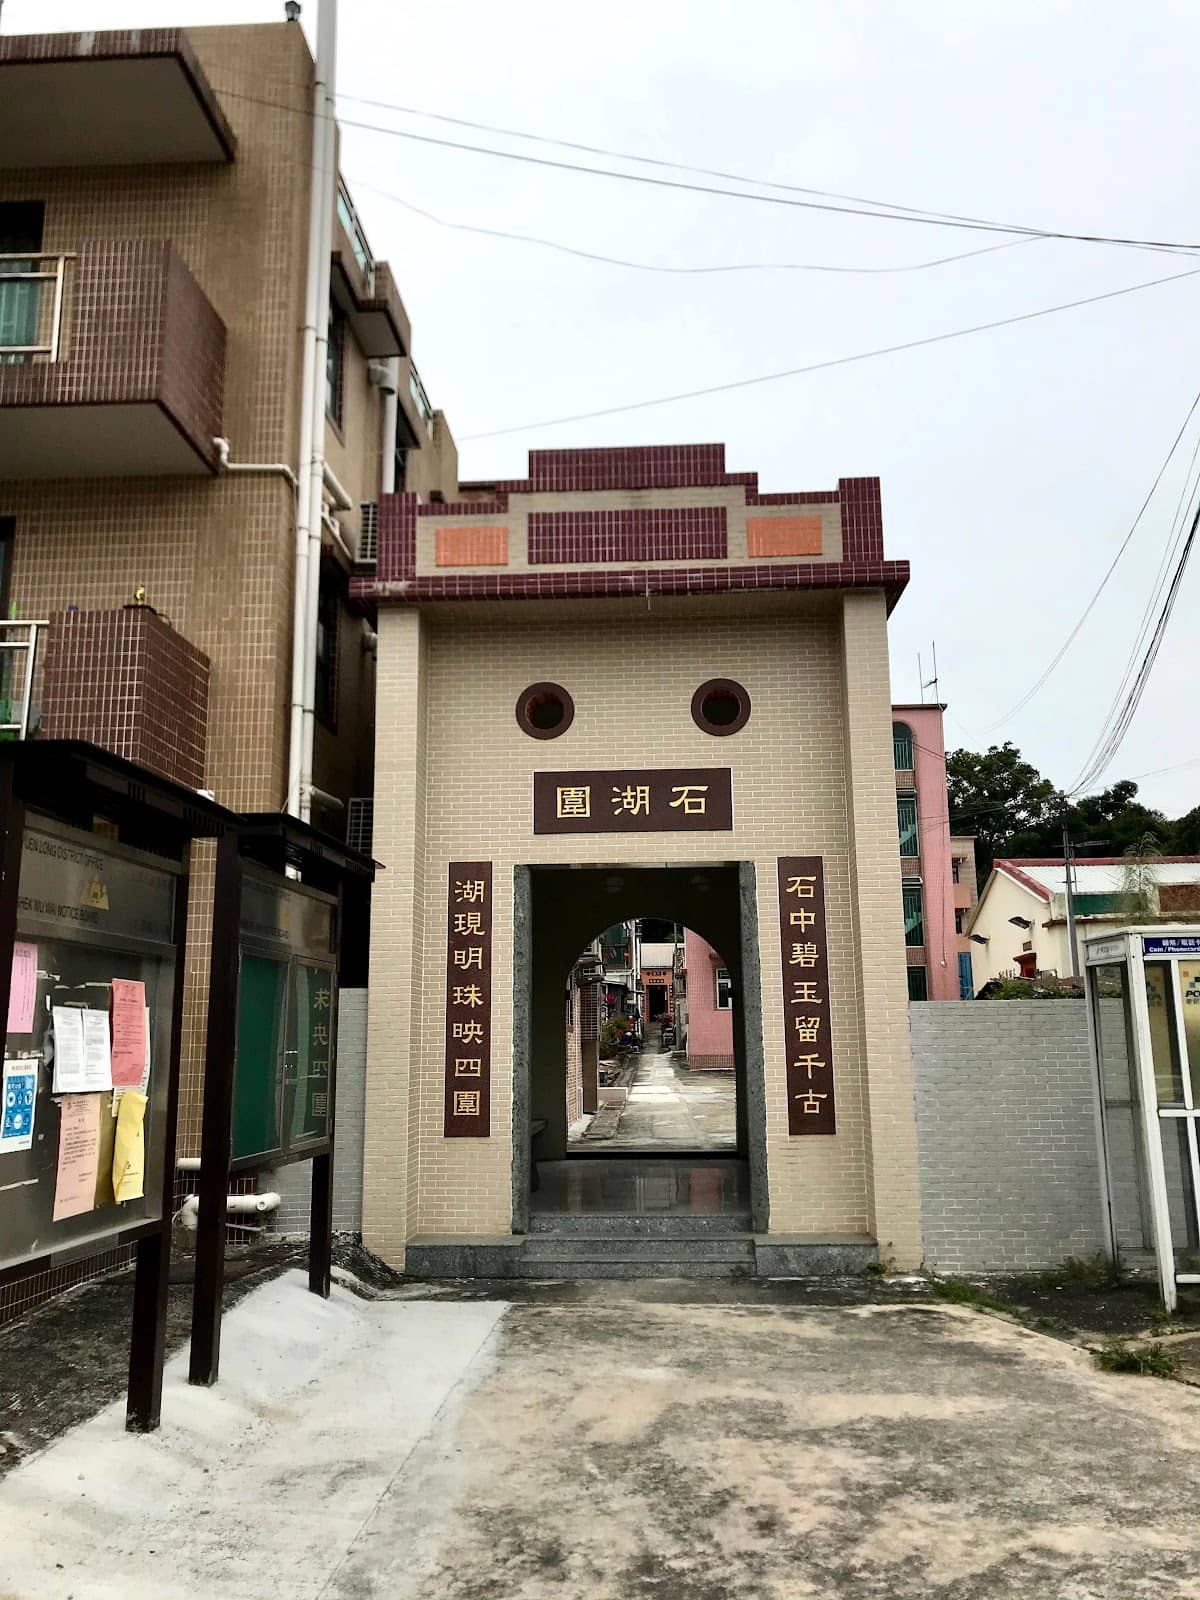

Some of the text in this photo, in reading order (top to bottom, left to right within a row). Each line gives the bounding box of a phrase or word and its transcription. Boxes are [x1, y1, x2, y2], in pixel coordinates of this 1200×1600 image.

[453, 880, 485, 1116] 湖現明珠映四圍
[786, 876, 828, 1114] 石中碧玉留千古
